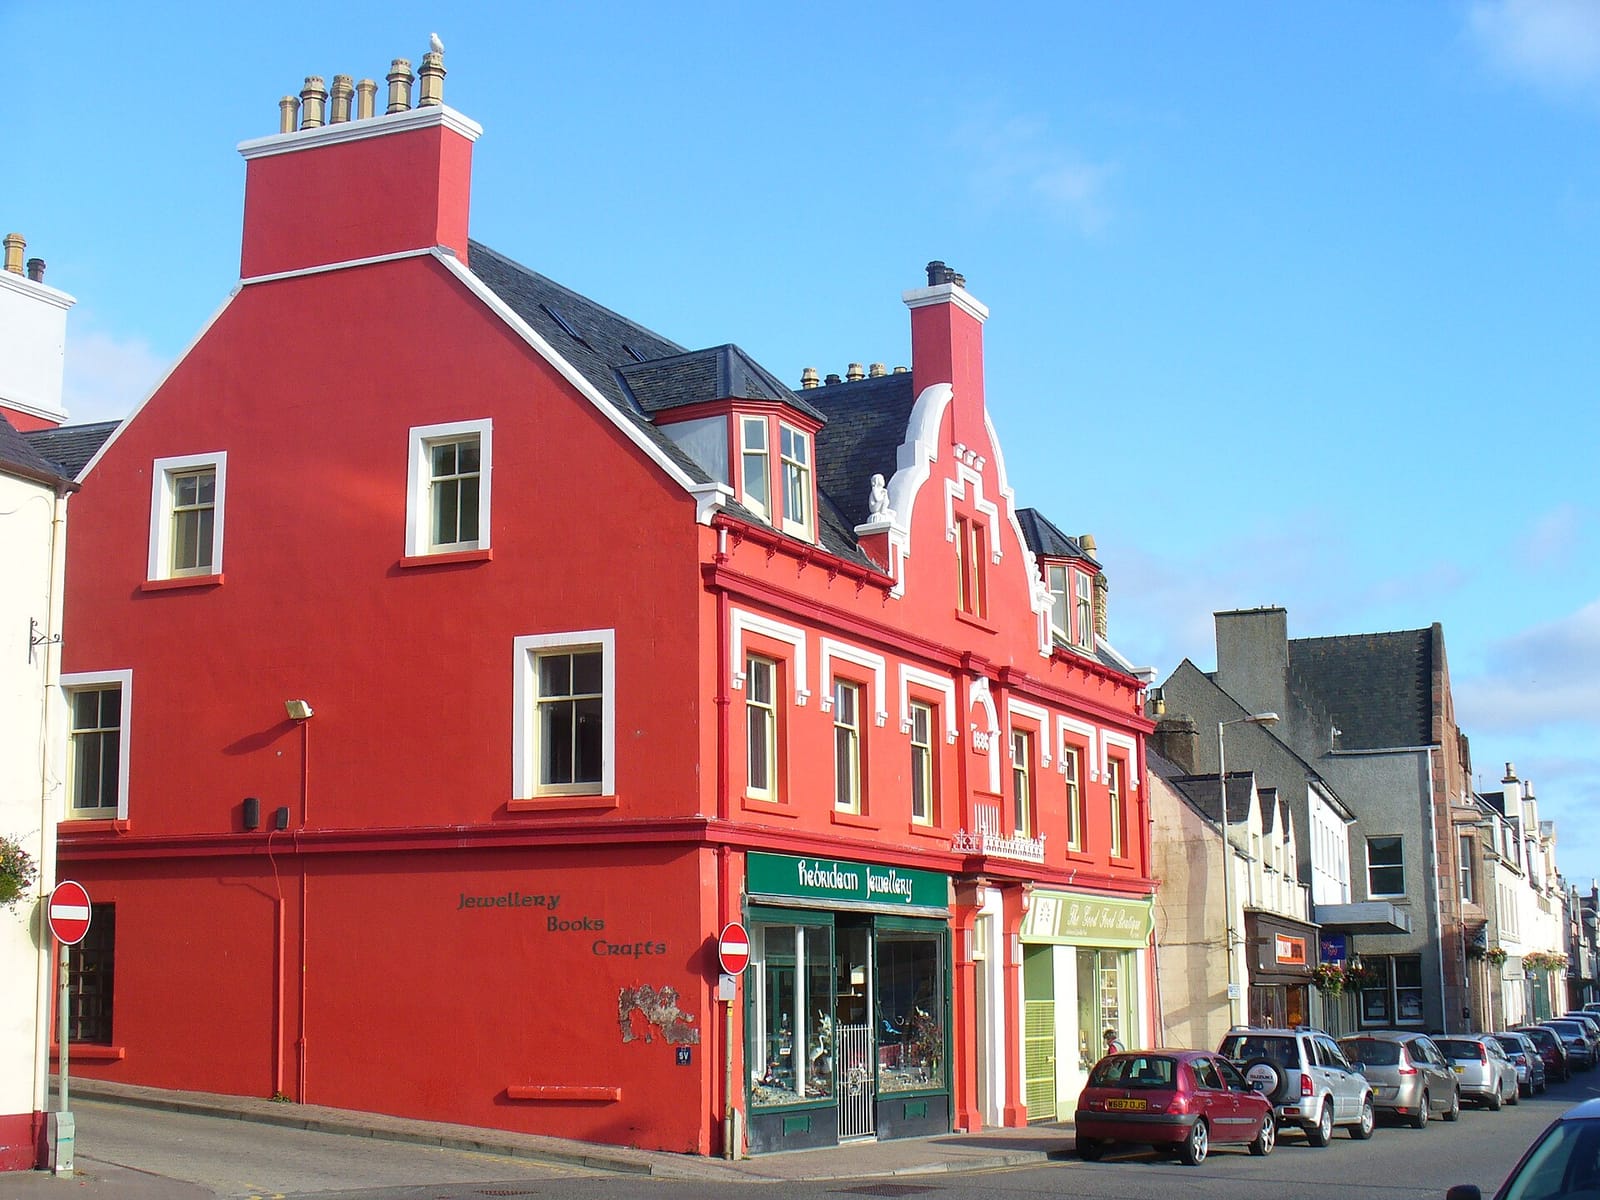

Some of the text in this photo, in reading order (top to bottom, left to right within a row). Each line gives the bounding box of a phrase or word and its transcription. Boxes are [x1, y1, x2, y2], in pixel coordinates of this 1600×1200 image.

[798, 860, 912, 903] Hebridean Jewellery
[457, 892, 560, 910] Jewellery
[547, 916, 605, 932] Books
[592, 940, 666, 959] Crafts
